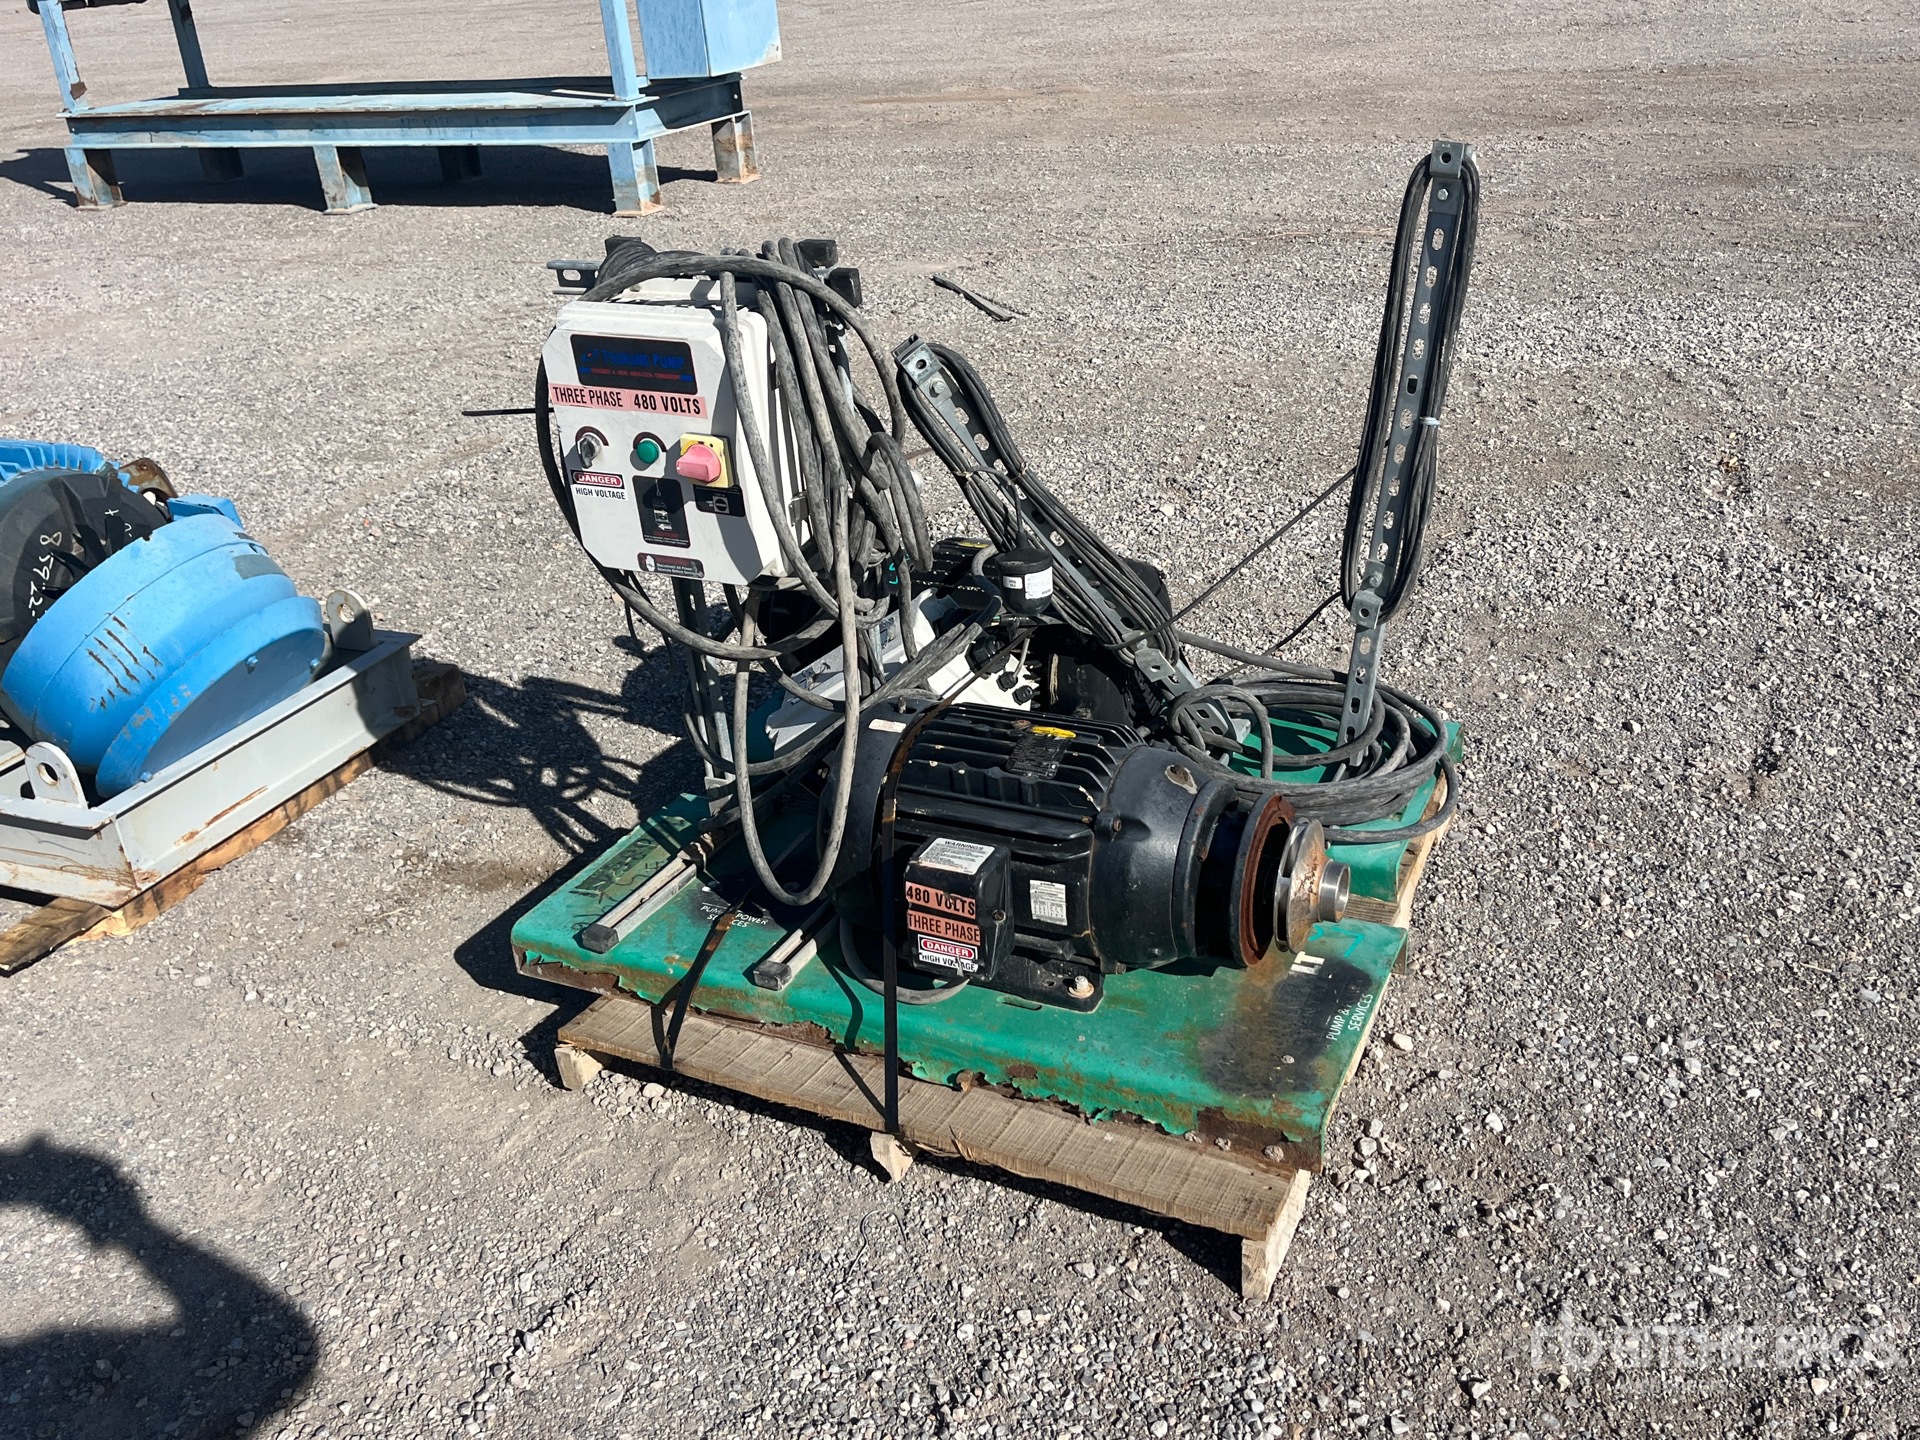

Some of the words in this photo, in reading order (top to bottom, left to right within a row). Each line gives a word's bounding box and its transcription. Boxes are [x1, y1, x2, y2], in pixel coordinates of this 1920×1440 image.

[552, 386, 587, 405] THREE
[588, 389, 624, 408] PHASE
[633, 393, 657, 411] 480
[660, 395, 701, 415] VOLTS
[577, 473, 618, 485] DANGER
[575, 487, 594, 497] HIGH
[594, 489, 626, 500] VOLTAGE
[906, 885, 930, 904] 480
[935, 892, 976, 916] VOLTS
[735, 912, 769, 925] POWER
[908, 913, 942, 934] THREE
[944, 921, 980, 943] PHASE
[921, 954, 940, 964] HIGH
[926, 941, 969, 957] DANGER
[1347, 993, 1374, 1032] SERVICES
[1325, 1014, 1346, 1041] PUMP
